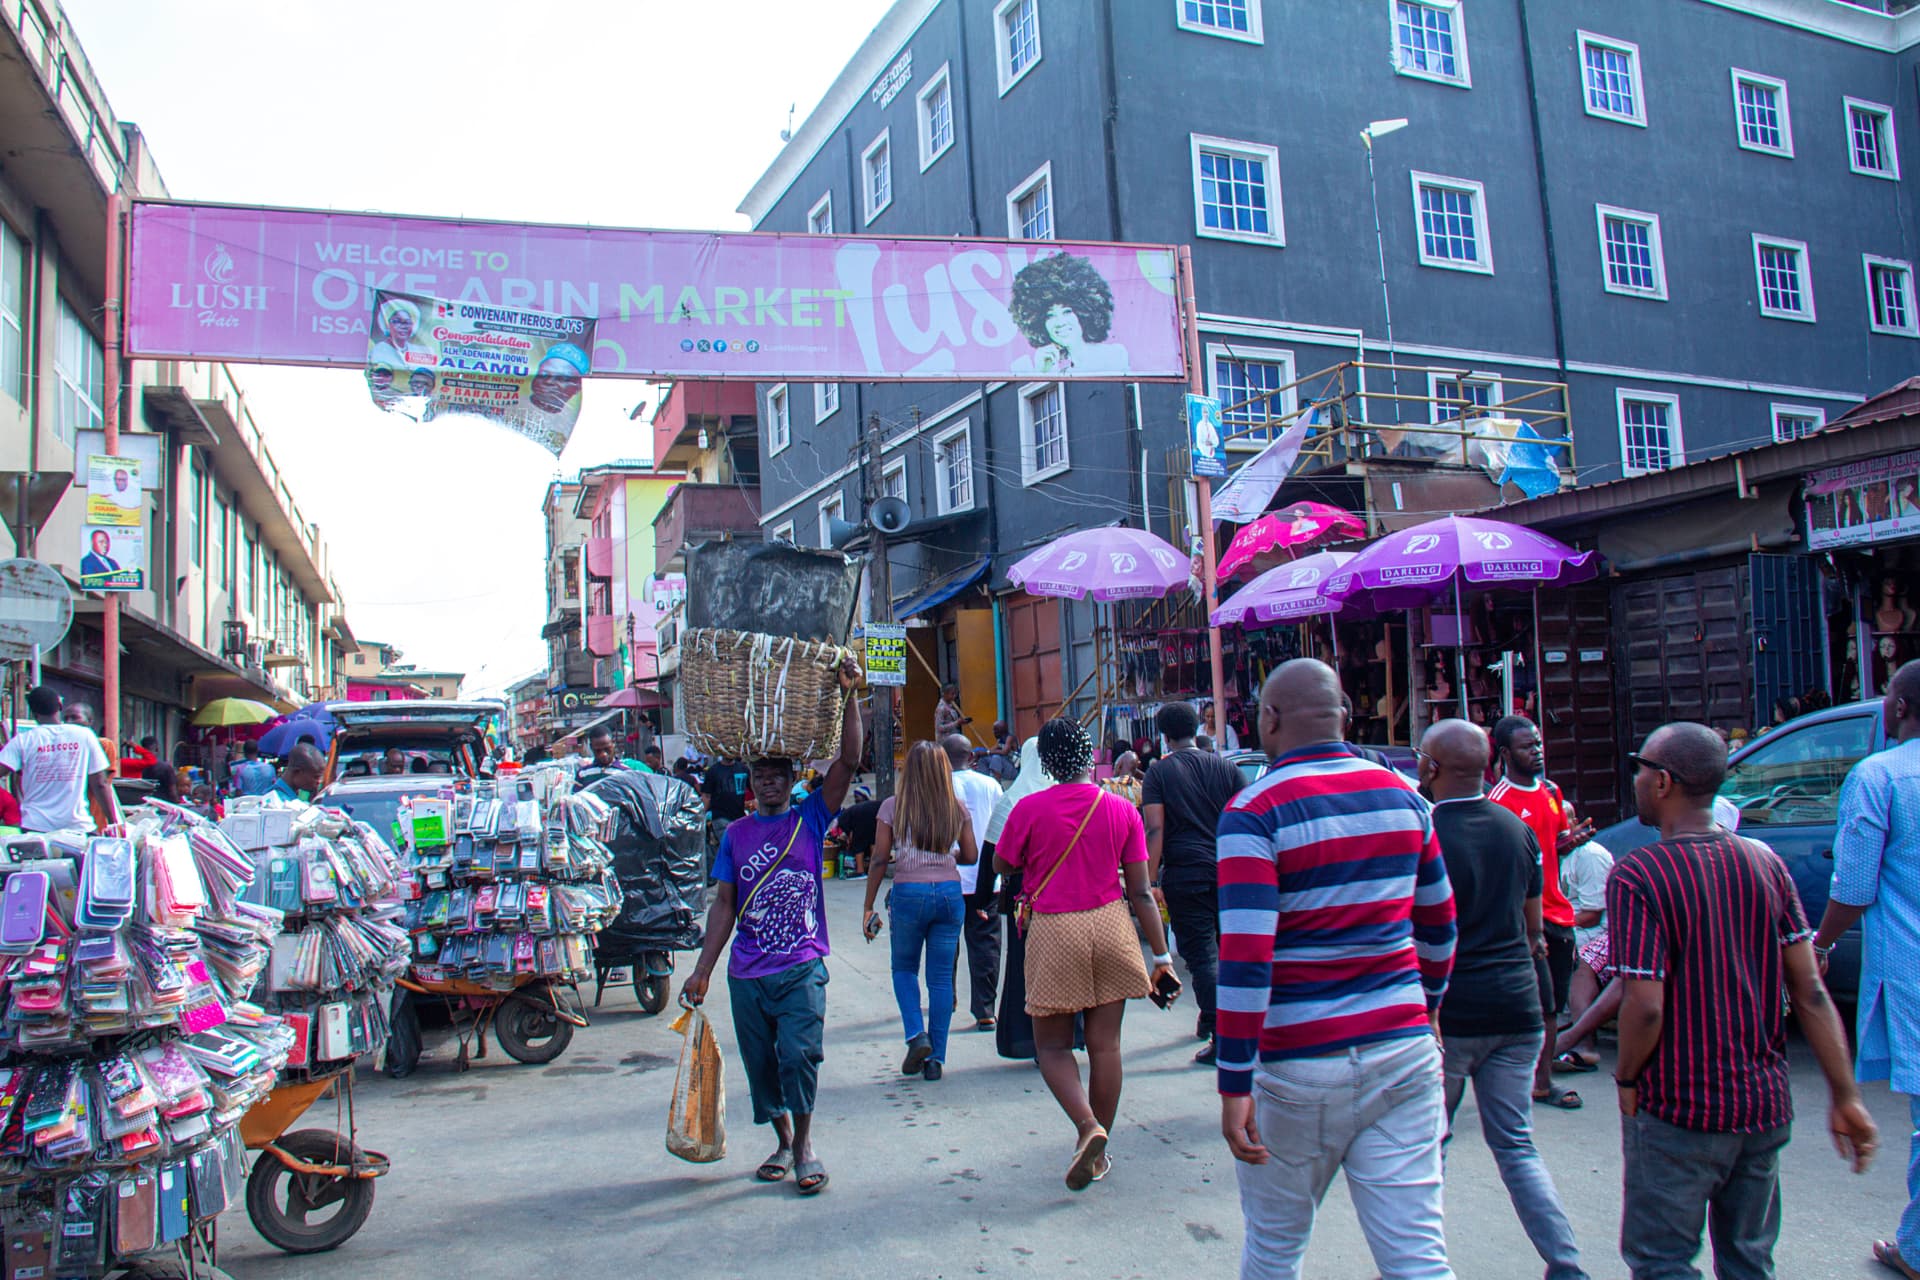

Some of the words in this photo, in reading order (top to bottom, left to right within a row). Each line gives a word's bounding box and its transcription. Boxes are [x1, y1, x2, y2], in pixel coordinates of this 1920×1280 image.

[315, 241, 465, 269] WELCOME
[471, 251, 509, 272] TO
[168, 282, 270, 311] LUSH
[619, 283, 855, 328] MARKET
[198, 310, 240, 328] Hair
[312, 315, 368, 335] ISSA
[460, 305, 519, 323] CONVENANT
[520, 314, 551, 328] HEROS
[554, 318, 583, 333] GUY'S
[433, 327, 532, 349] Congratulation
[462, 349, 502, 361] ADENIRAN
[502, 353, 529, 364] IDOWU
[439, 357, 530, 377] ALAMU
[454, 387, 491, 399] BABA
[1384, 566, 1436, 578] DARLING
[1486, 561, 1539, 572] DARLING
[1275, 599, 1325, 612] DARLING
[868, 659, 899, 667] SSCE
[740, 842, 779, 882] ORIS
